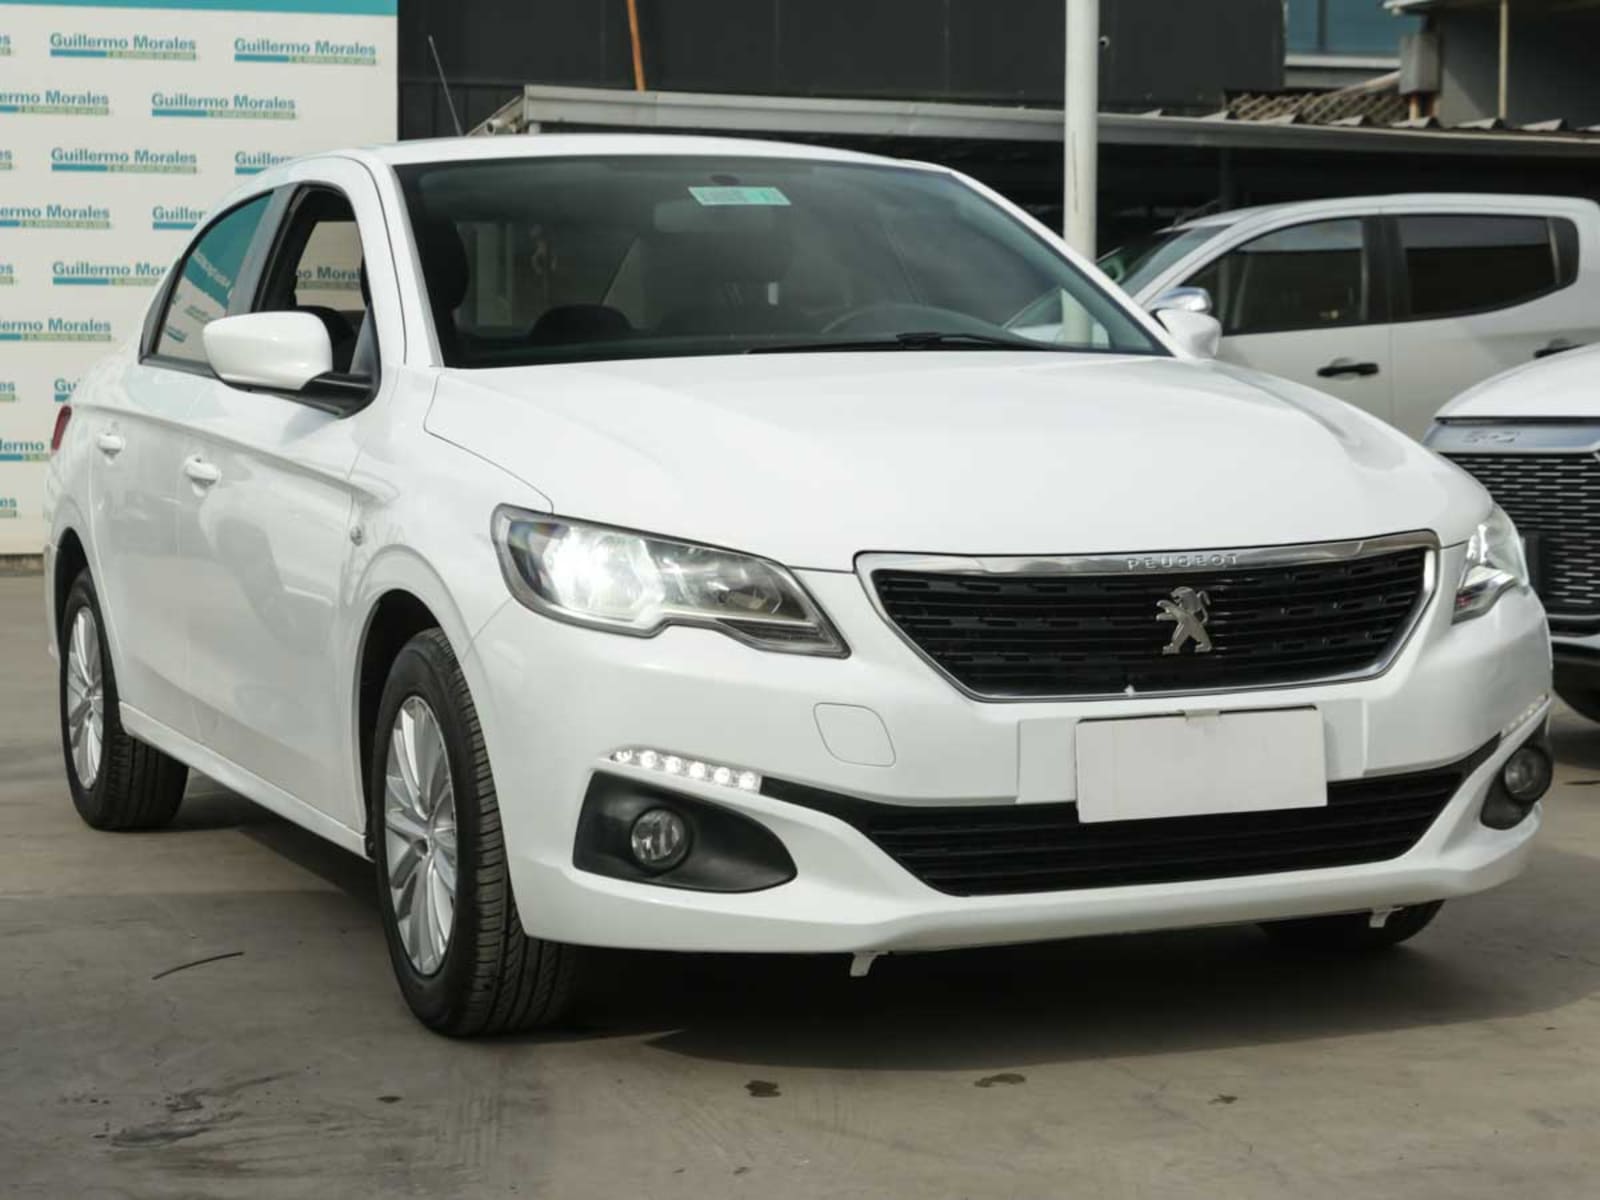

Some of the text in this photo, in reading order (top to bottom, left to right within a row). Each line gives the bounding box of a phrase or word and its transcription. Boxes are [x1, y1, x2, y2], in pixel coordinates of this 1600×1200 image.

[50, 33, 196, 50] Guillermo Morales
[234, 38, 376, 56] Guillermo Morales
[45, 90, 109, 105] Morales
[151, 93, 296, 110] Guillermo Morales
[51, 148, 197, 164] Guillermo Morales
[46, 204, 110, 219] Morales
[53, 262, 131, 276] Guillermo
[48, 317, 111, 332] Morales
[1127, 554, 1238, 570] PEUGEOT
